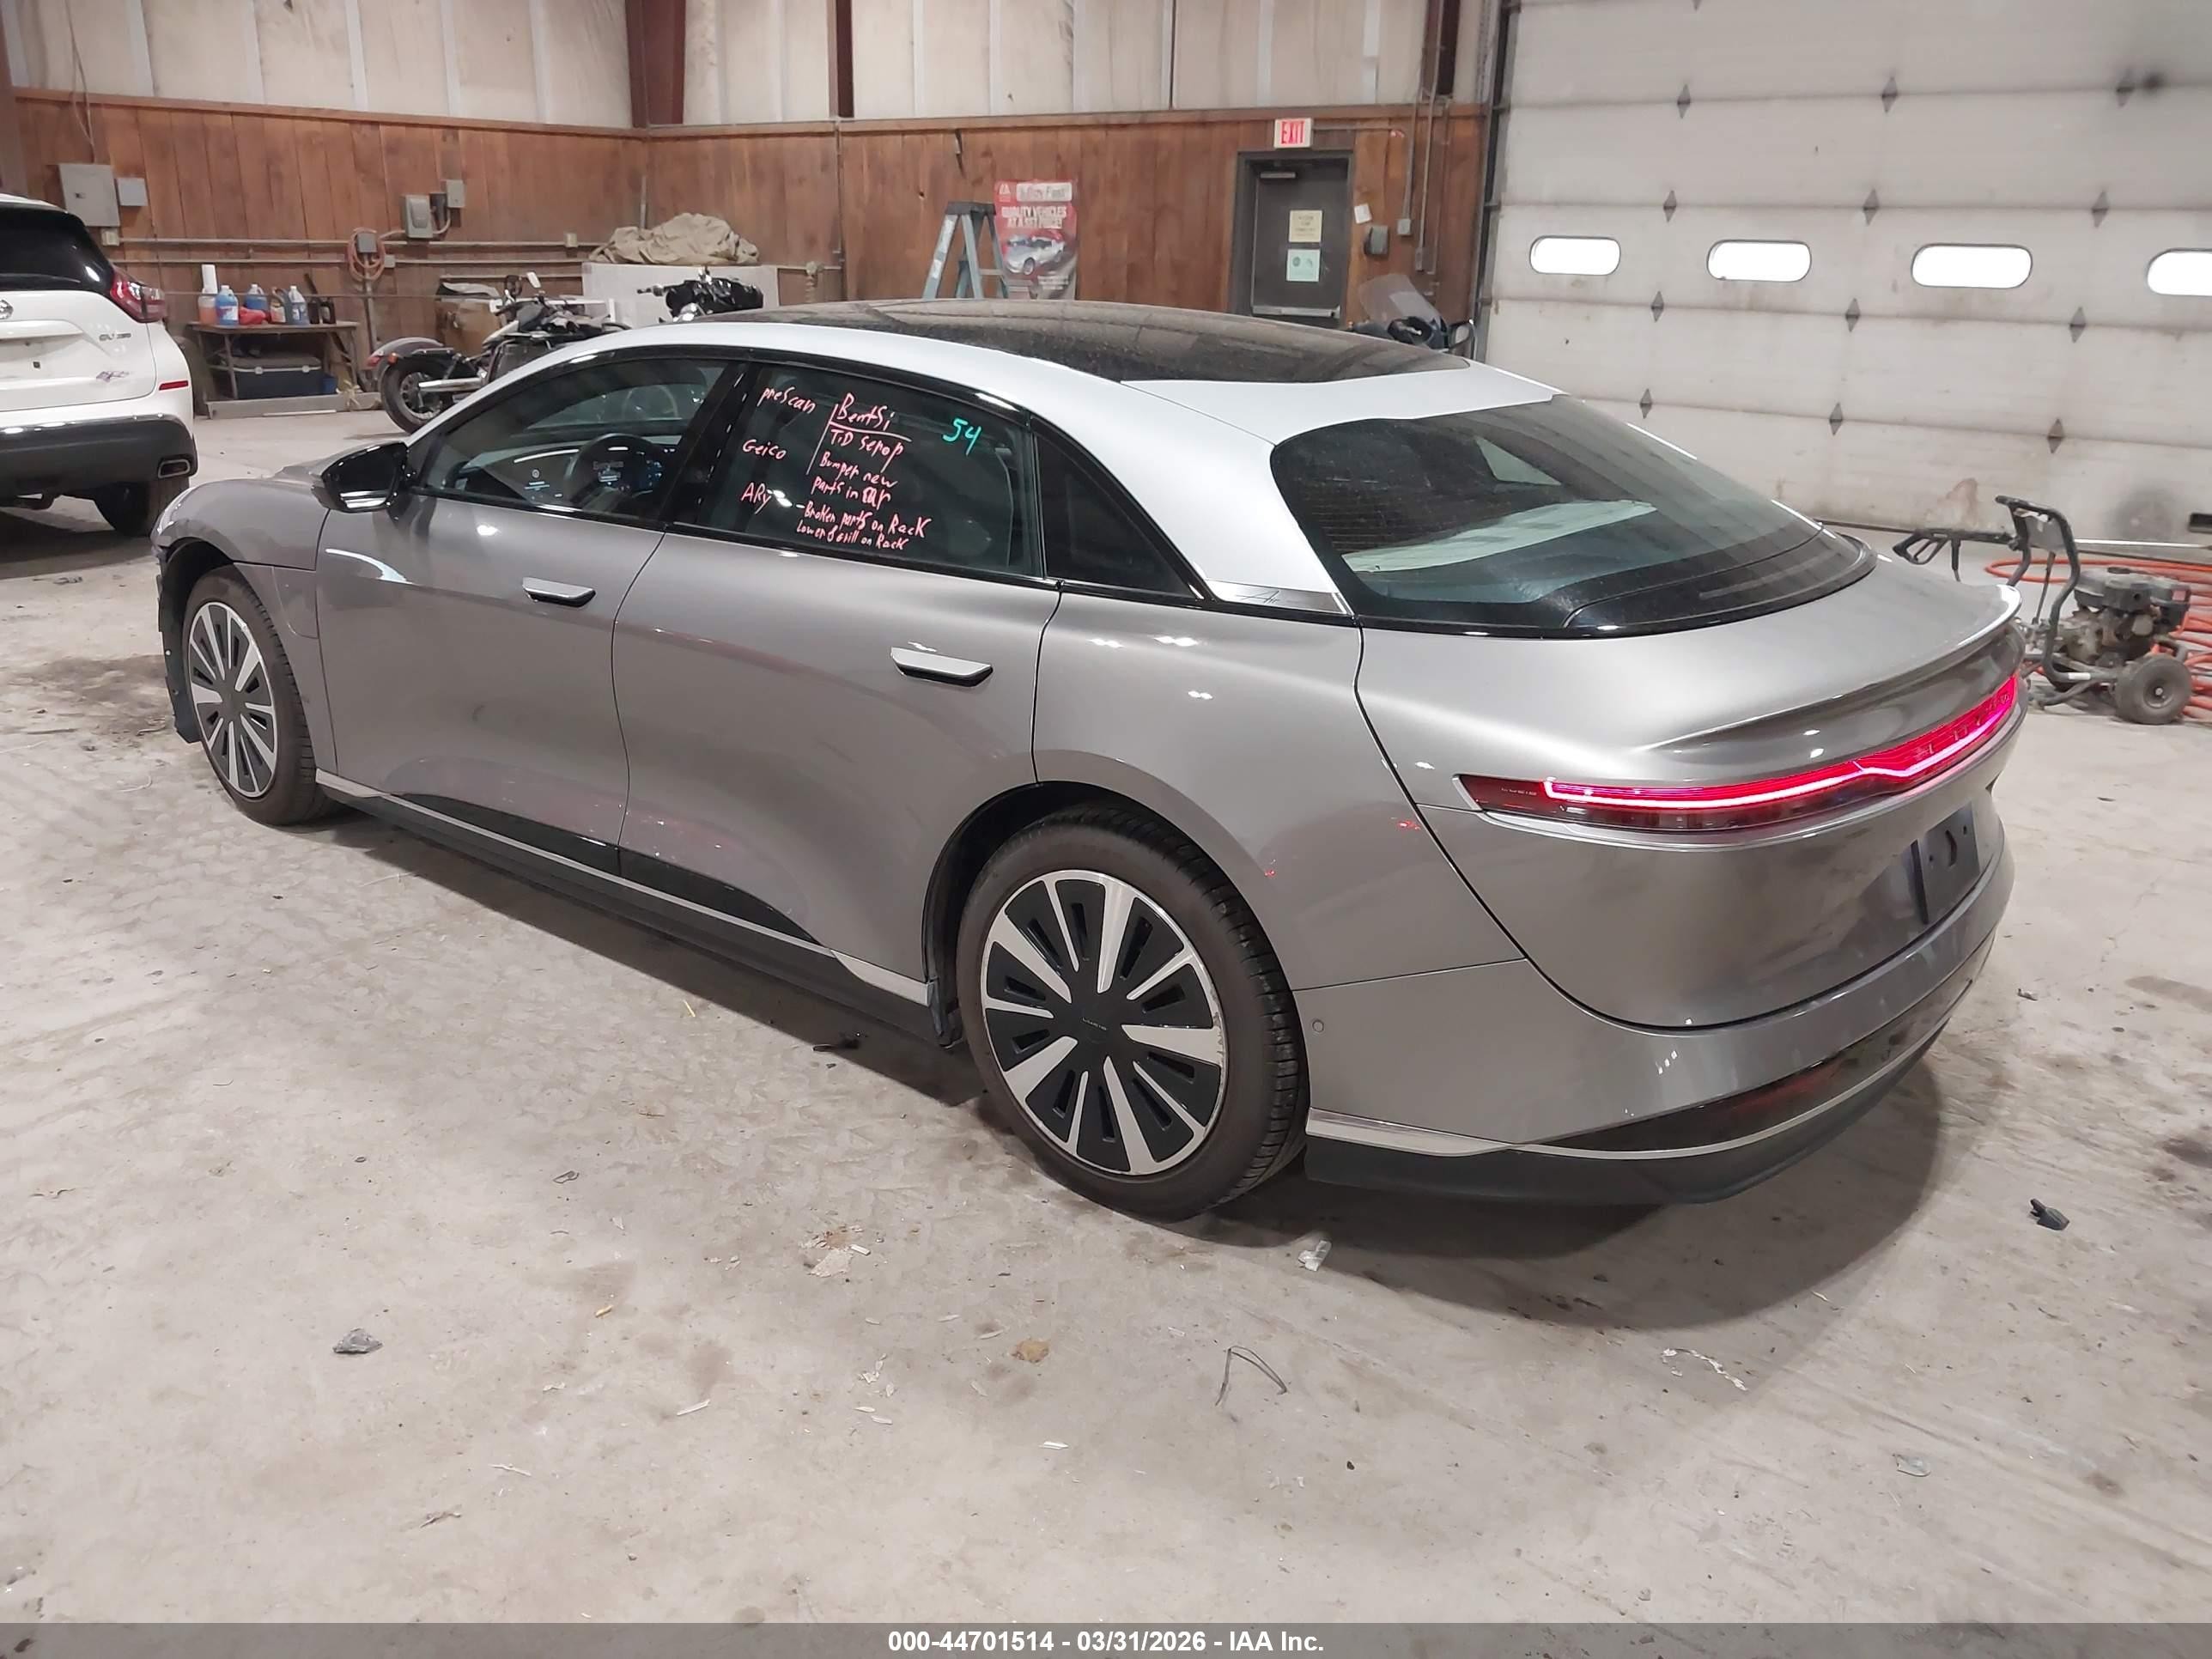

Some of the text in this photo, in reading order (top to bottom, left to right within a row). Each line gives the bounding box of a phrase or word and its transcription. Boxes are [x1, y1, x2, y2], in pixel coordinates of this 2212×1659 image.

[1281, 121, 1304, 143] EXIT
[942, 418, 982, 456] 54
[863, 472, 898, 488] new
[846, 486, 859, 499] in
[872, 523, 884, 532] on
[860, 537, 872, 545] on
